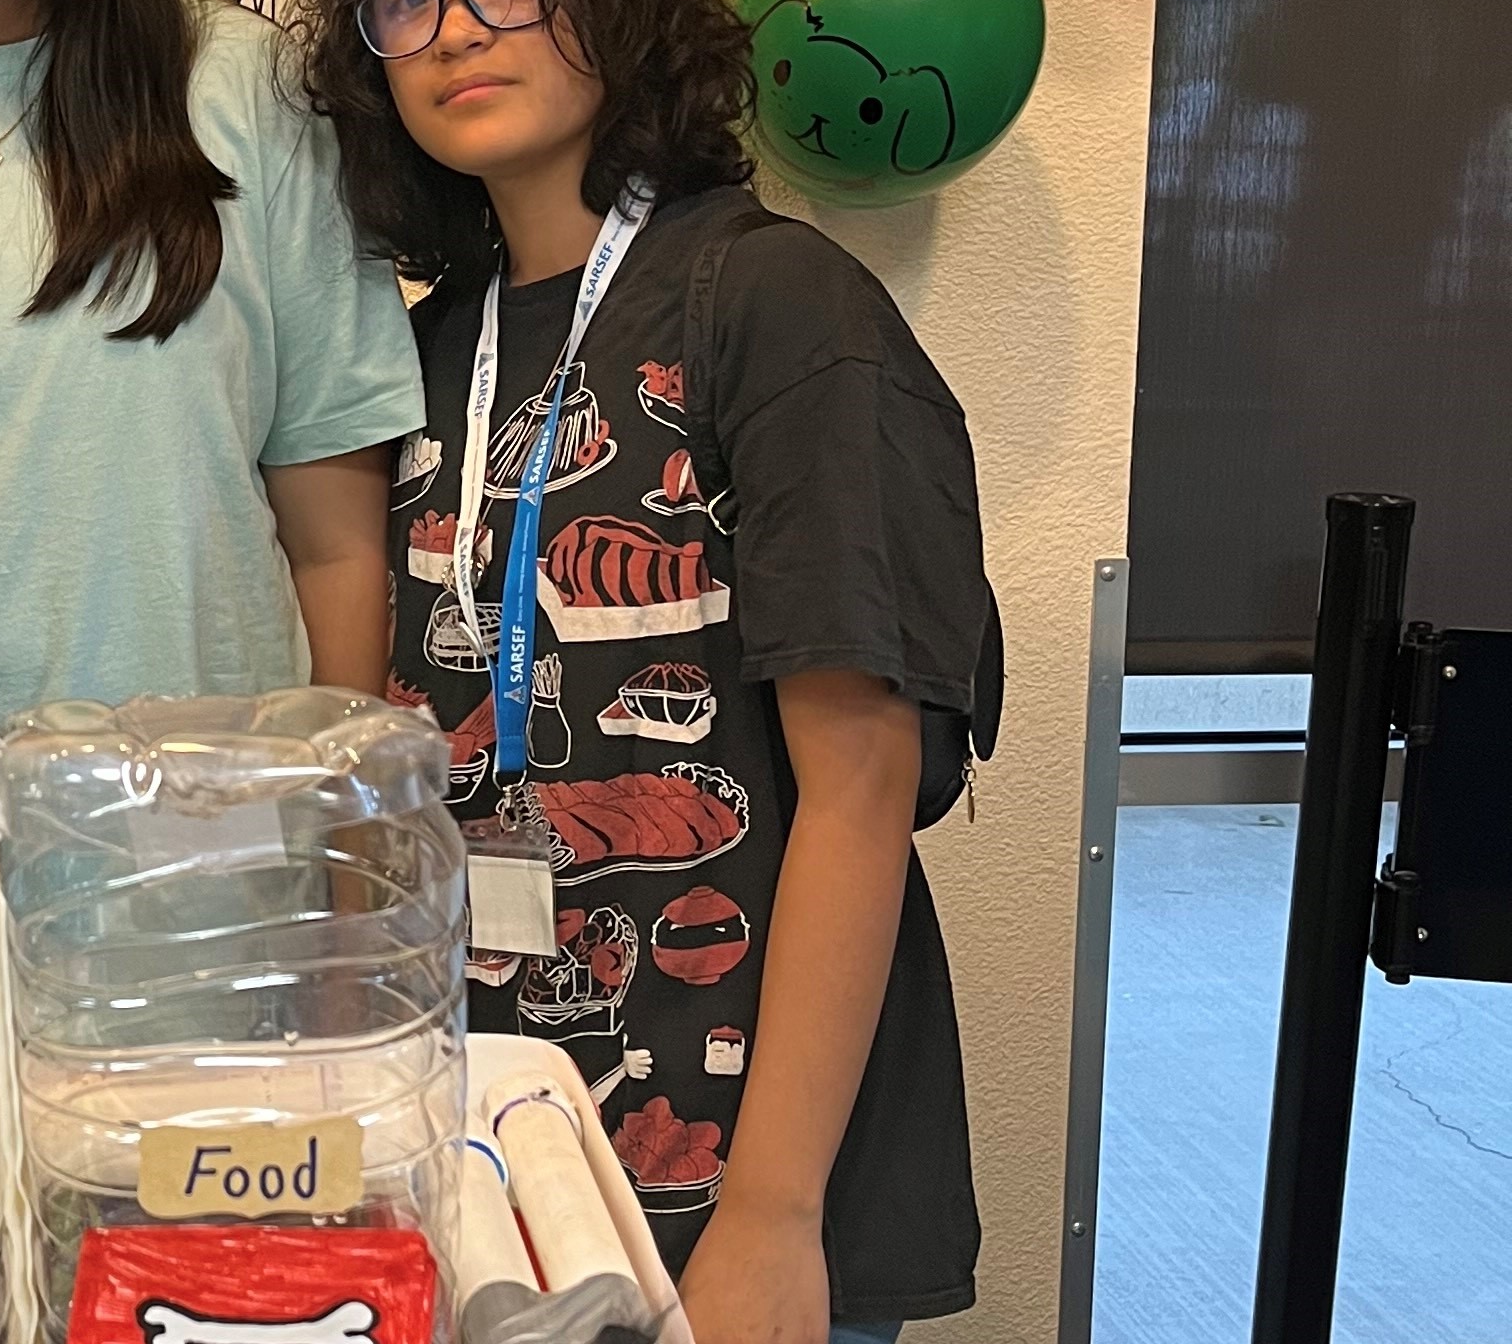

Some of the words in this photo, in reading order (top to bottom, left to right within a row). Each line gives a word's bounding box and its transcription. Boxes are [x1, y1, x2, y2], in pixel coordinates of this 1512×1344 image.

[585, 242, 614, 299] SARSEF
[509, 625, 527, 683] SARSEF
[184, 1137, 320, 1201] Food
